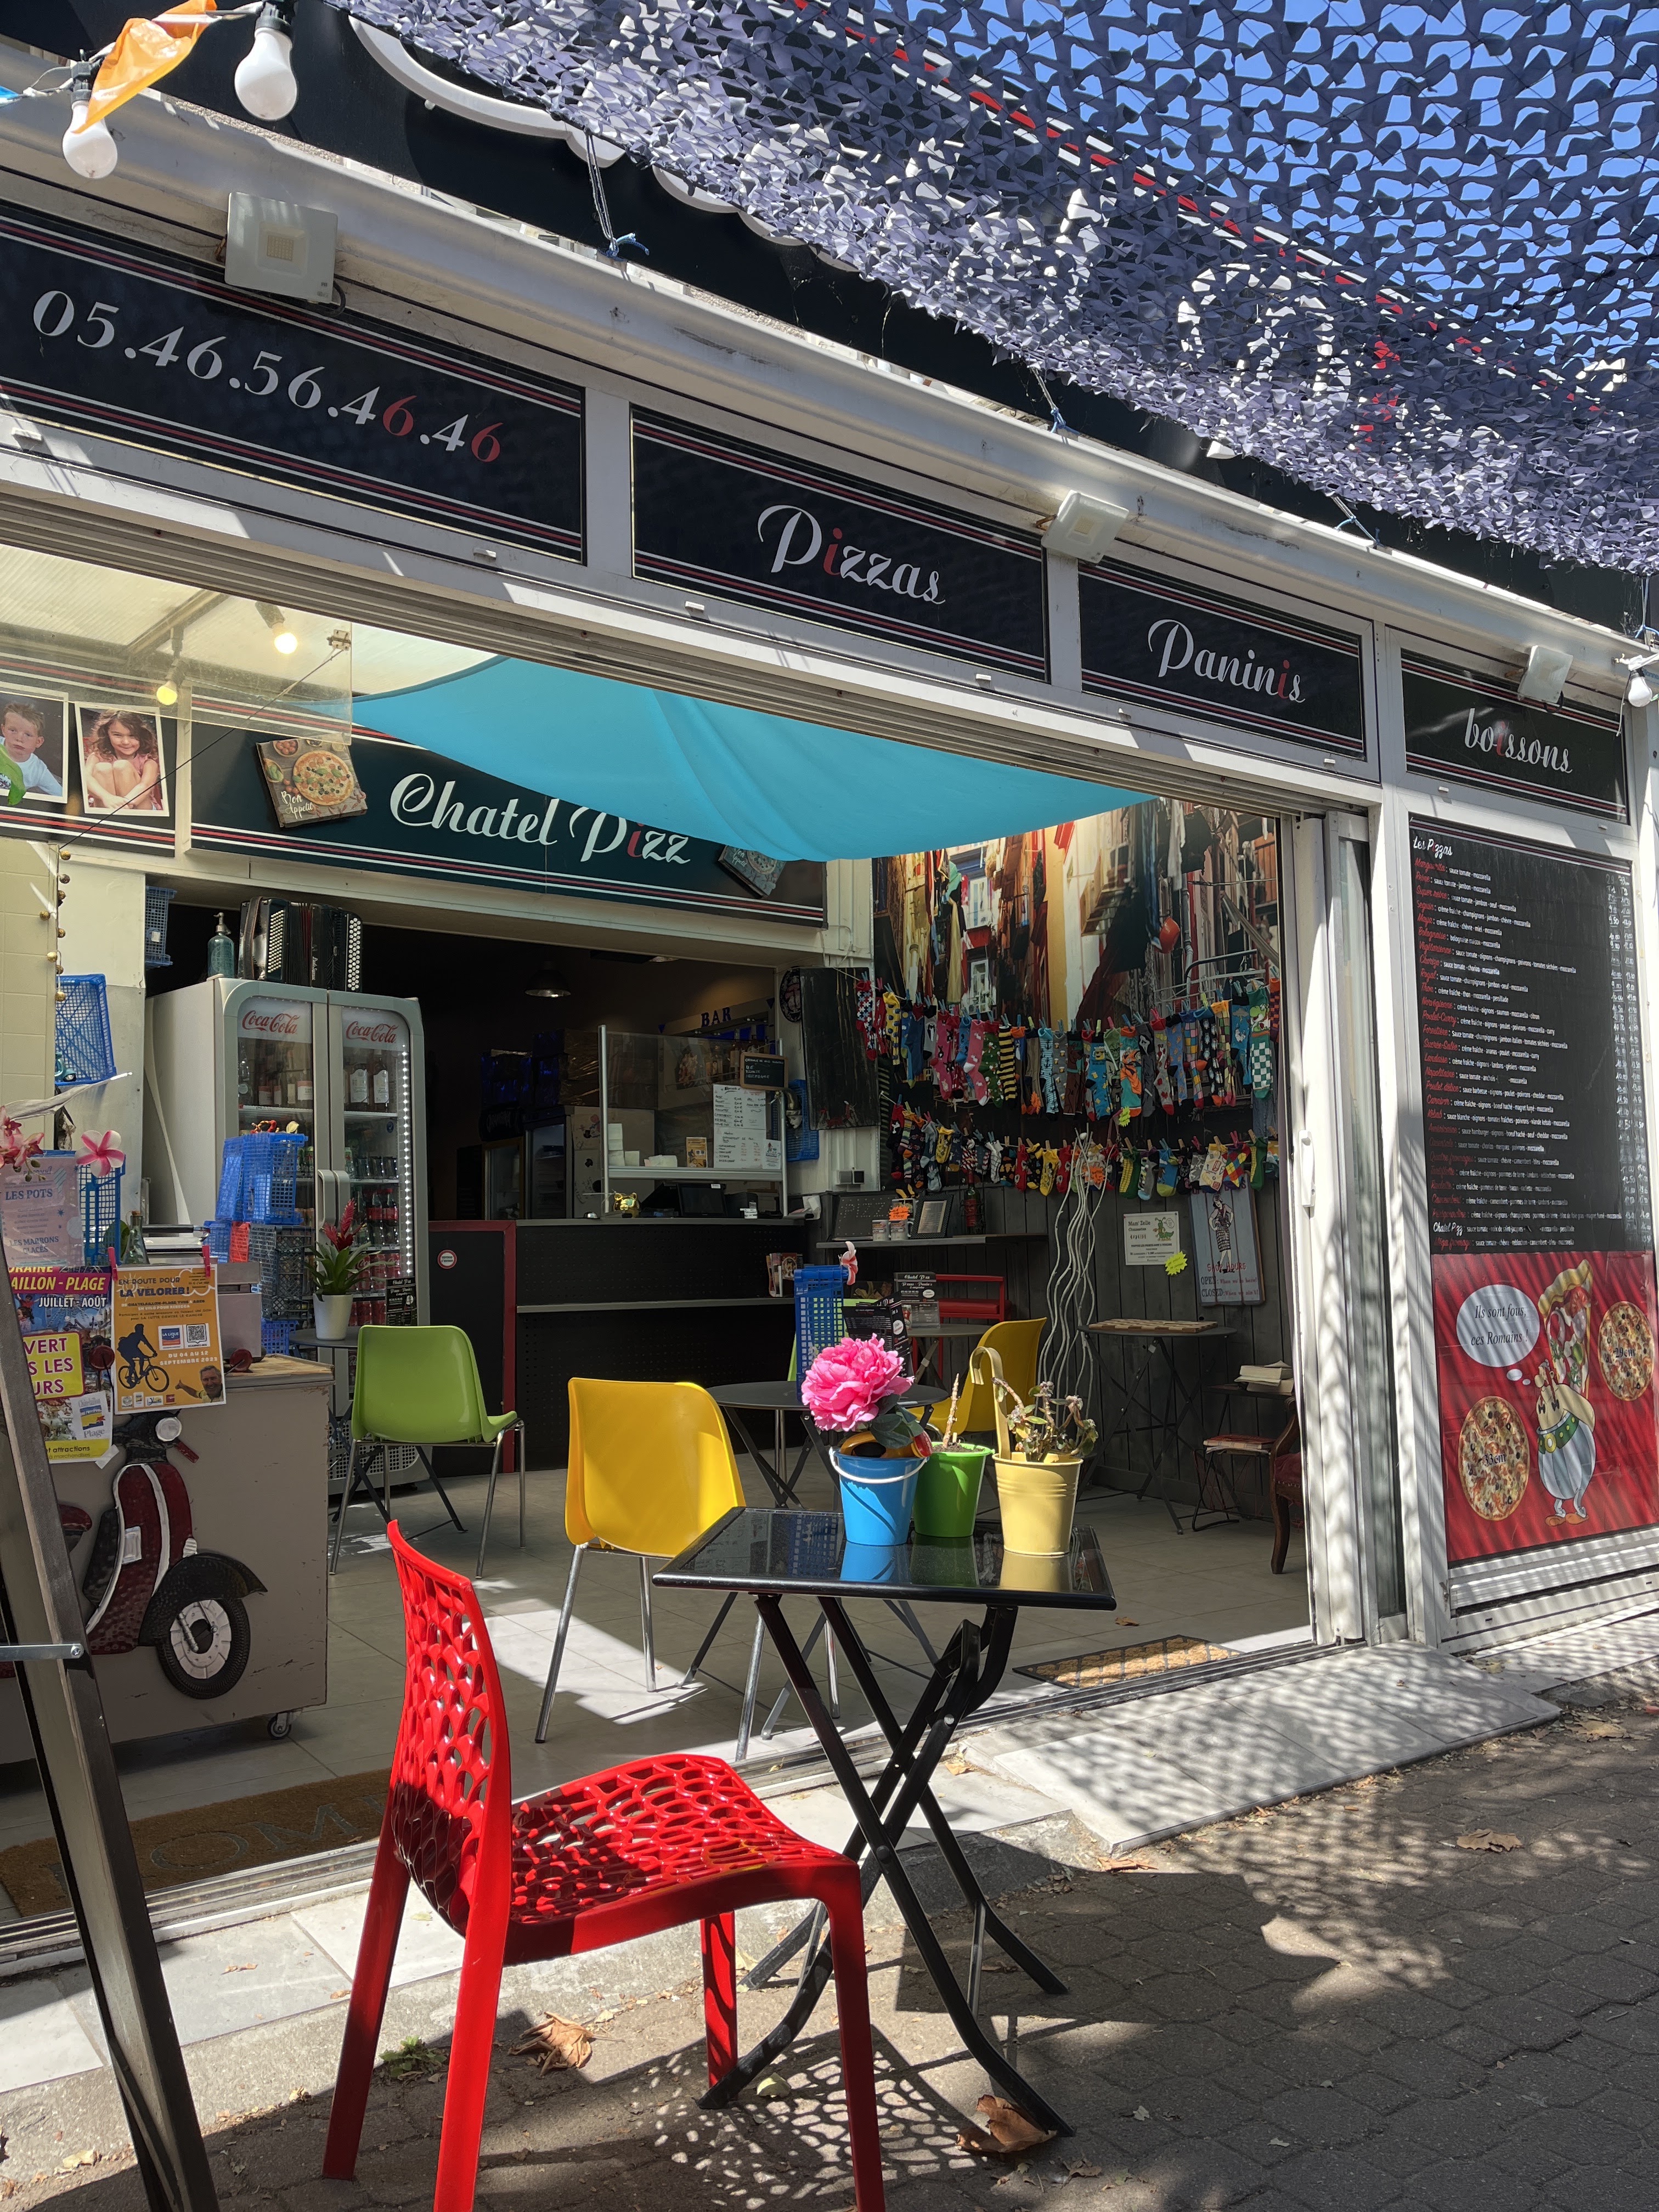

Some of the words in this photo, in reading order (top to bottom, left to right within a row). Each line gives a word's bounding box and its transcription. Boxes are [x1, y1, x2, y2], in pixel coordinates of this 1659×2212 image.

[32, 290, 504, 462] 05.46.56.46.46
[758, 505, 946, 605] Pizzas
[1147, 619, 1306, 703] Paninis
[1465, 708, 1573, 774] boissons
[281, 791, 303, 806] Bon
[390, 774, 560, 845] Chatel
[1413, 836, 1426, 850] Les
[1427, 838, 1453, 857] Pizzas
[1420, 968, 1437, 984] Royal
[242, 1010, 301, 1034] Coca-Cola
[700, 1007, 731, 1027] BAR
[346, 1021, 399, 1043] Coca-Cola
[5, 1190, 24, 1200] LES
[27, 1188, 53, 1199] POTS
[1433, 1222, 1451, 1233] Chatel
[24, 1236, 59, 1246] MARRONS
[1226, 1262, 1247, 1272] HOURS
[65, 1277, 106, 1291] PLAGE
[120, 1289, 134, 1297] LA
[38, 1296, 74, 1308] JUILLET
[82, 1295, 106, 1307] AOÛT
[1475, 1304, 1485, 1319] Ils
[1487, 1306, 1505, 1318] sont
[1506, 1303, 1527, 1320] fous,
[1471, 1333, 1485, 1347] ces
[1487, 1330, 1522, 1345] Romains
[1615, 1346, 1636, 1358] 29cm
[45, 1357, 74, 1374] LES
[83, 1428, 105, 1438] Plage
[1484, 1451, 1508, 1466] 33cm
